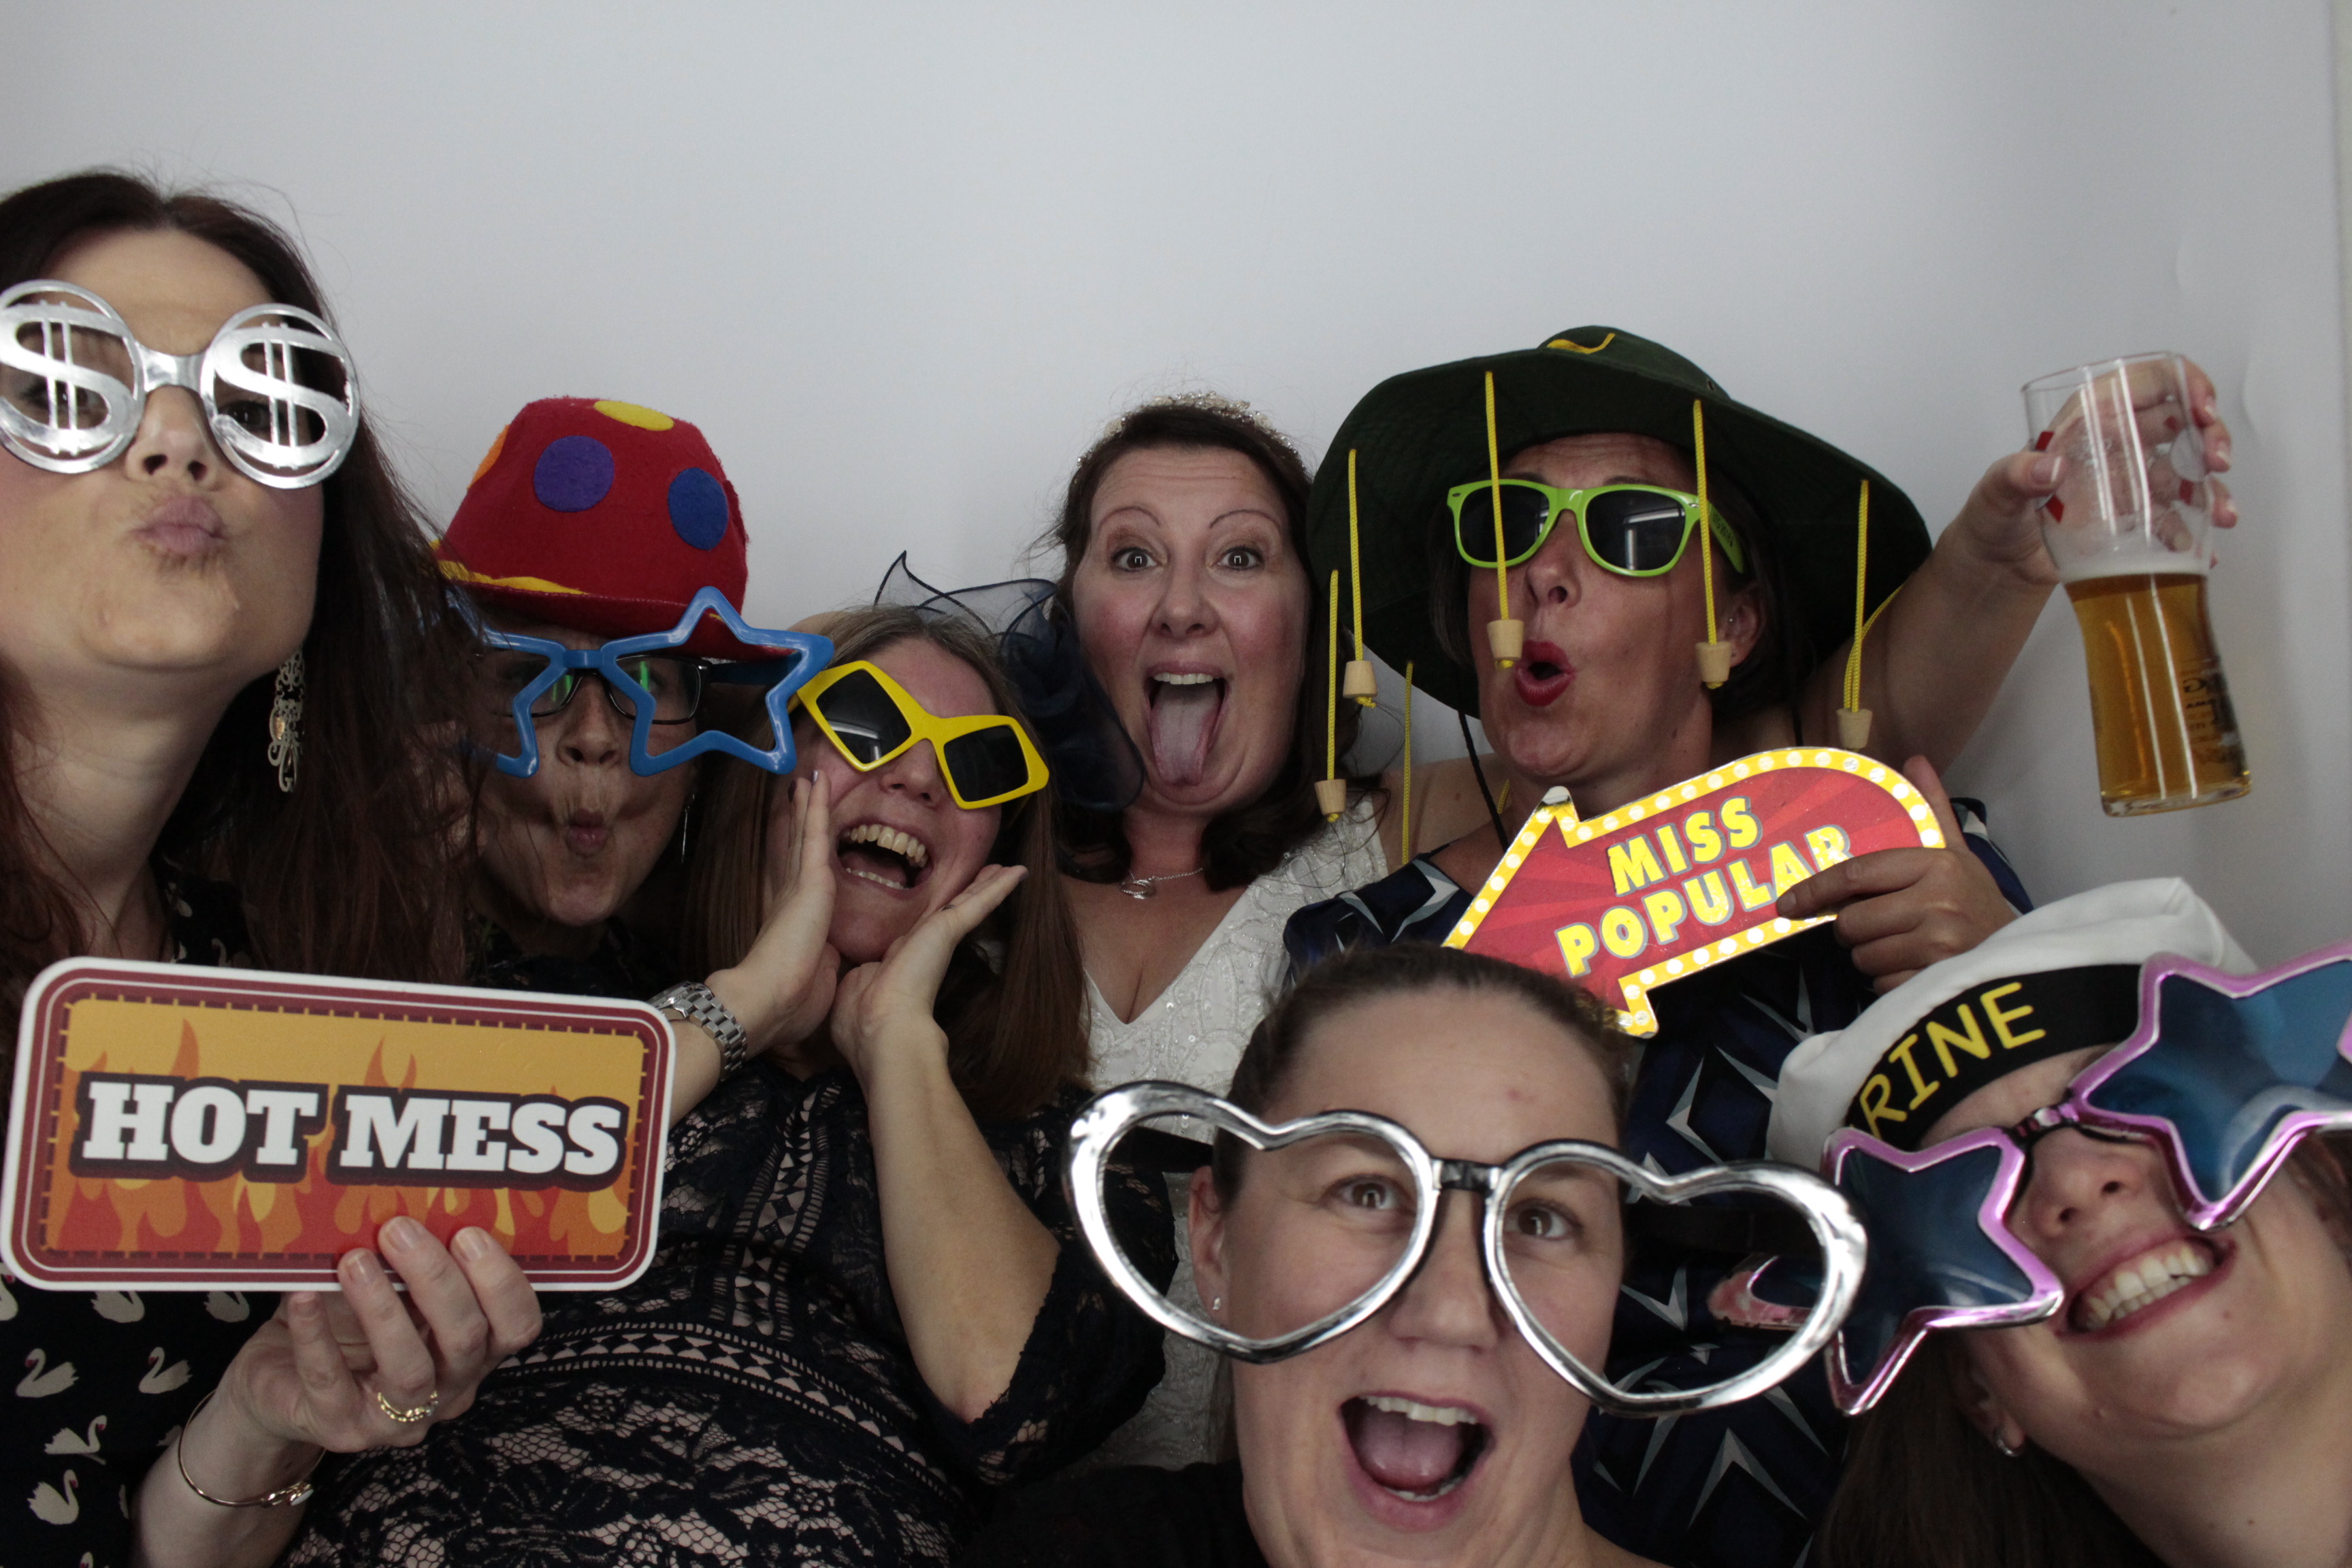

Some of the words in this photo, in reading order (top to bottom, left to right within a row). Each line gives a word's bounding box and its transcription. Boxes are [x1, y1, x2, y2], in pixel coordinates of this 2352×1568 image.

[1555, 824, 1855, 978] POPULAR
[1607, 796, 1761, 896] MISS
[1849, 982, 2046, 1141] RINE
[82, 1081, 319, 1165] HOT
[339, 1094, 621, 1175] MESS
